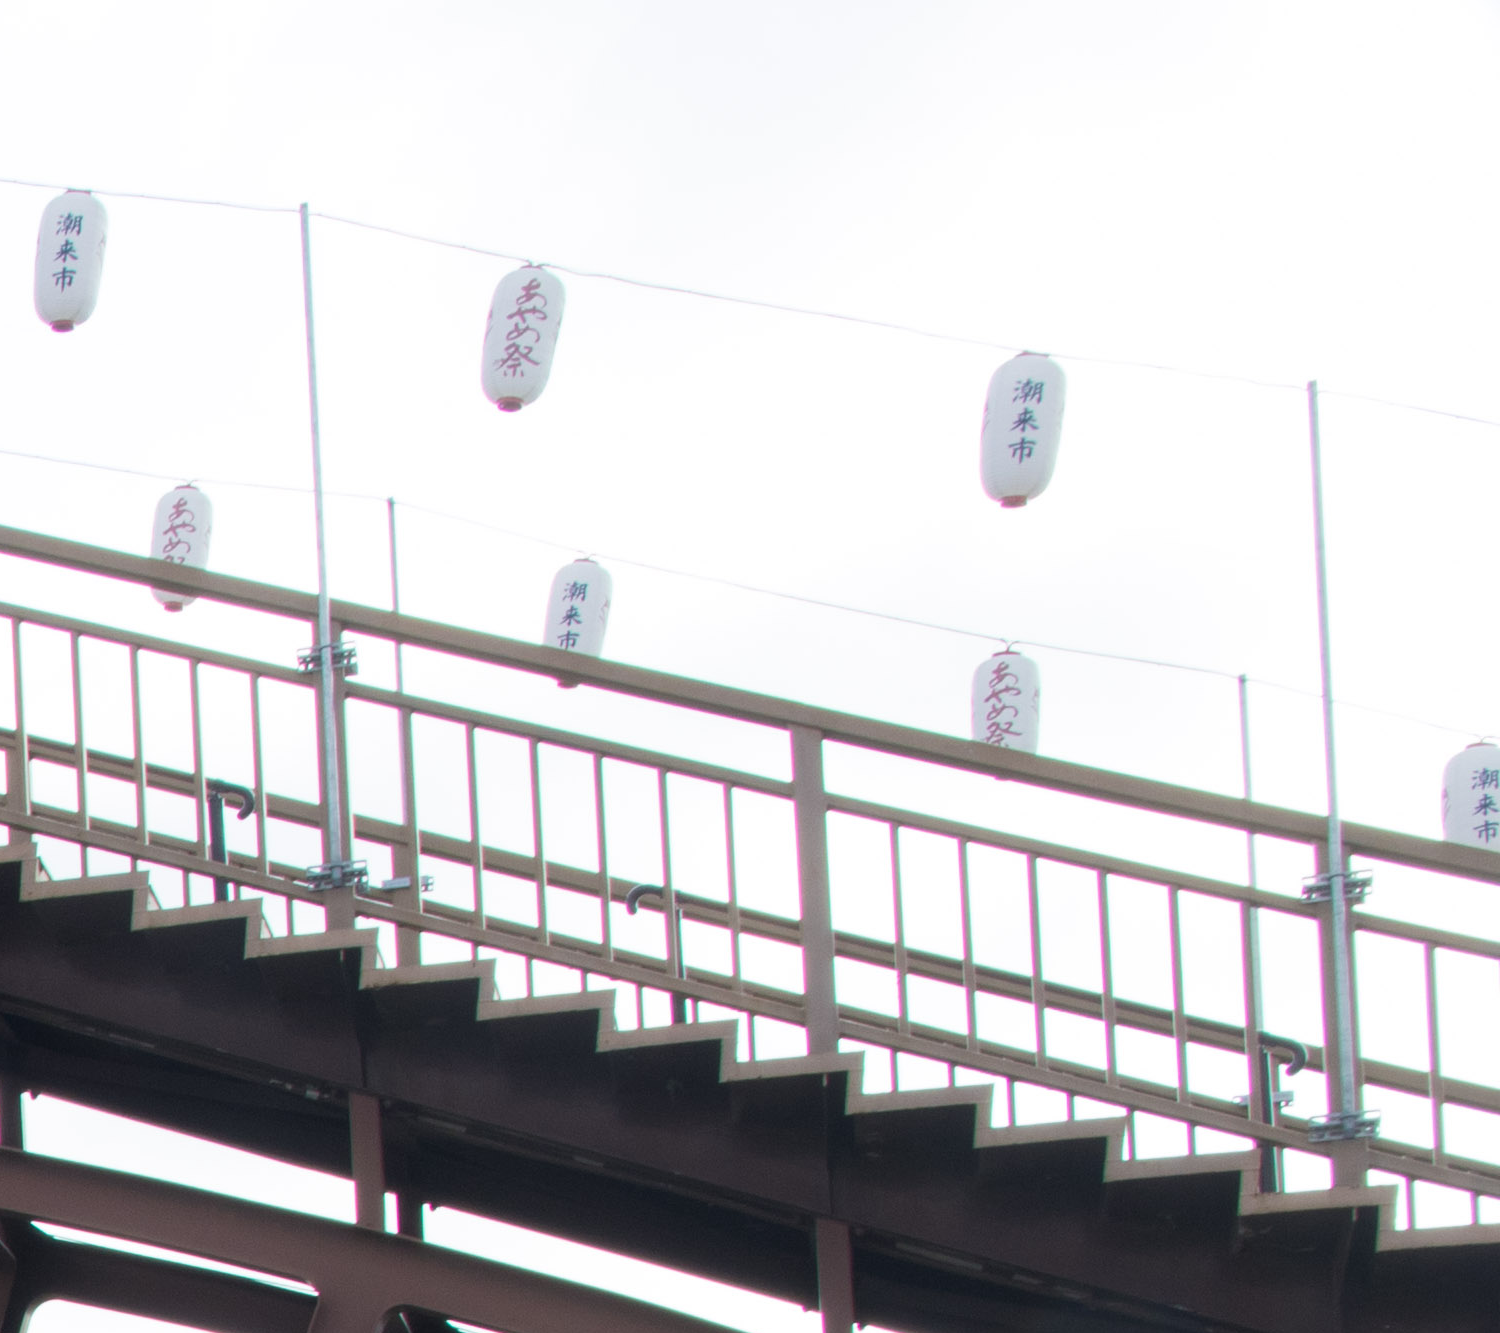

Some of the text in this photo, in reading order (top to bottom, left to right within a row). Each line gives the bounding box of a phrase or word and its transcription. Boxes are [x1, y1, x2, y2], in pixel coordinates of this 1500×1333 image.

[50, 212, 84, 292] 潮来市
[495, 278, 547, 377] あやめ祭
[1007, 378, 1044, 464] 潮来市
[557, 582, 587, 650] 潮来市
[1472, 767, 1500, 843] 潮来市
